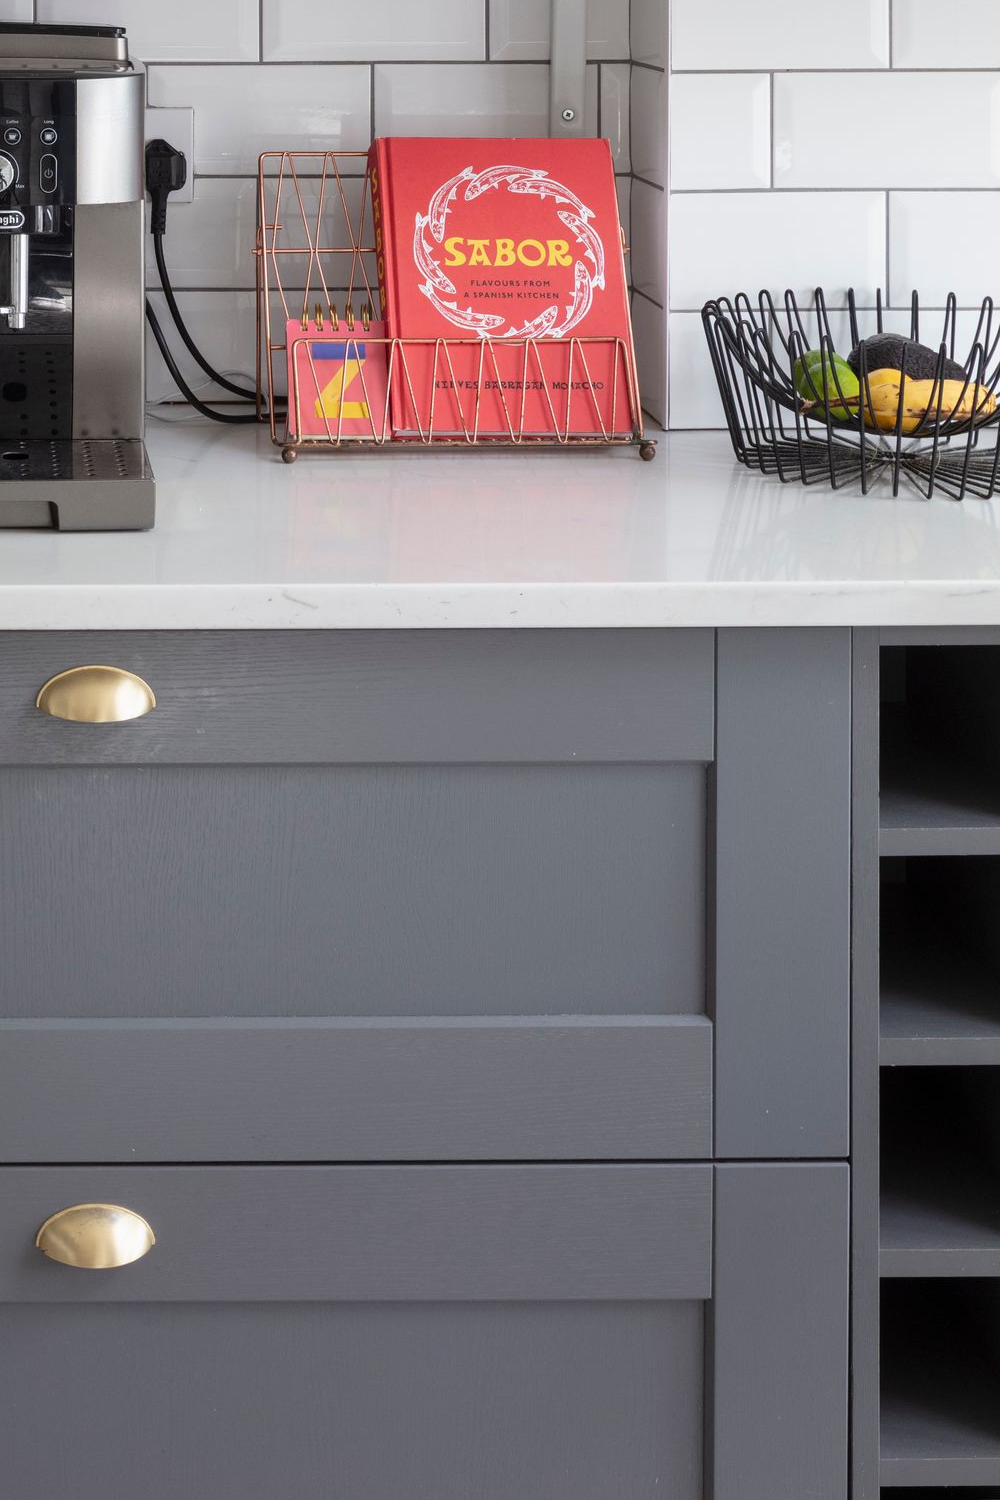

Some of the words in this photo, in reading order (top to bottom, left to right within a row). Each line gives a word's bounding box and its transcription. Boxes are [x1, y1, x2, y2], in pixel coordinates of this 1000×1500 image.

[371, 167, 386, 310] SABOR
[444, 237, 573, 267] SABOR
[470, 279, 520, 287] FLAVOURS
[473, 291, 513, 299] SPANISH
[516, 291, 559, 299] KITCHEN
